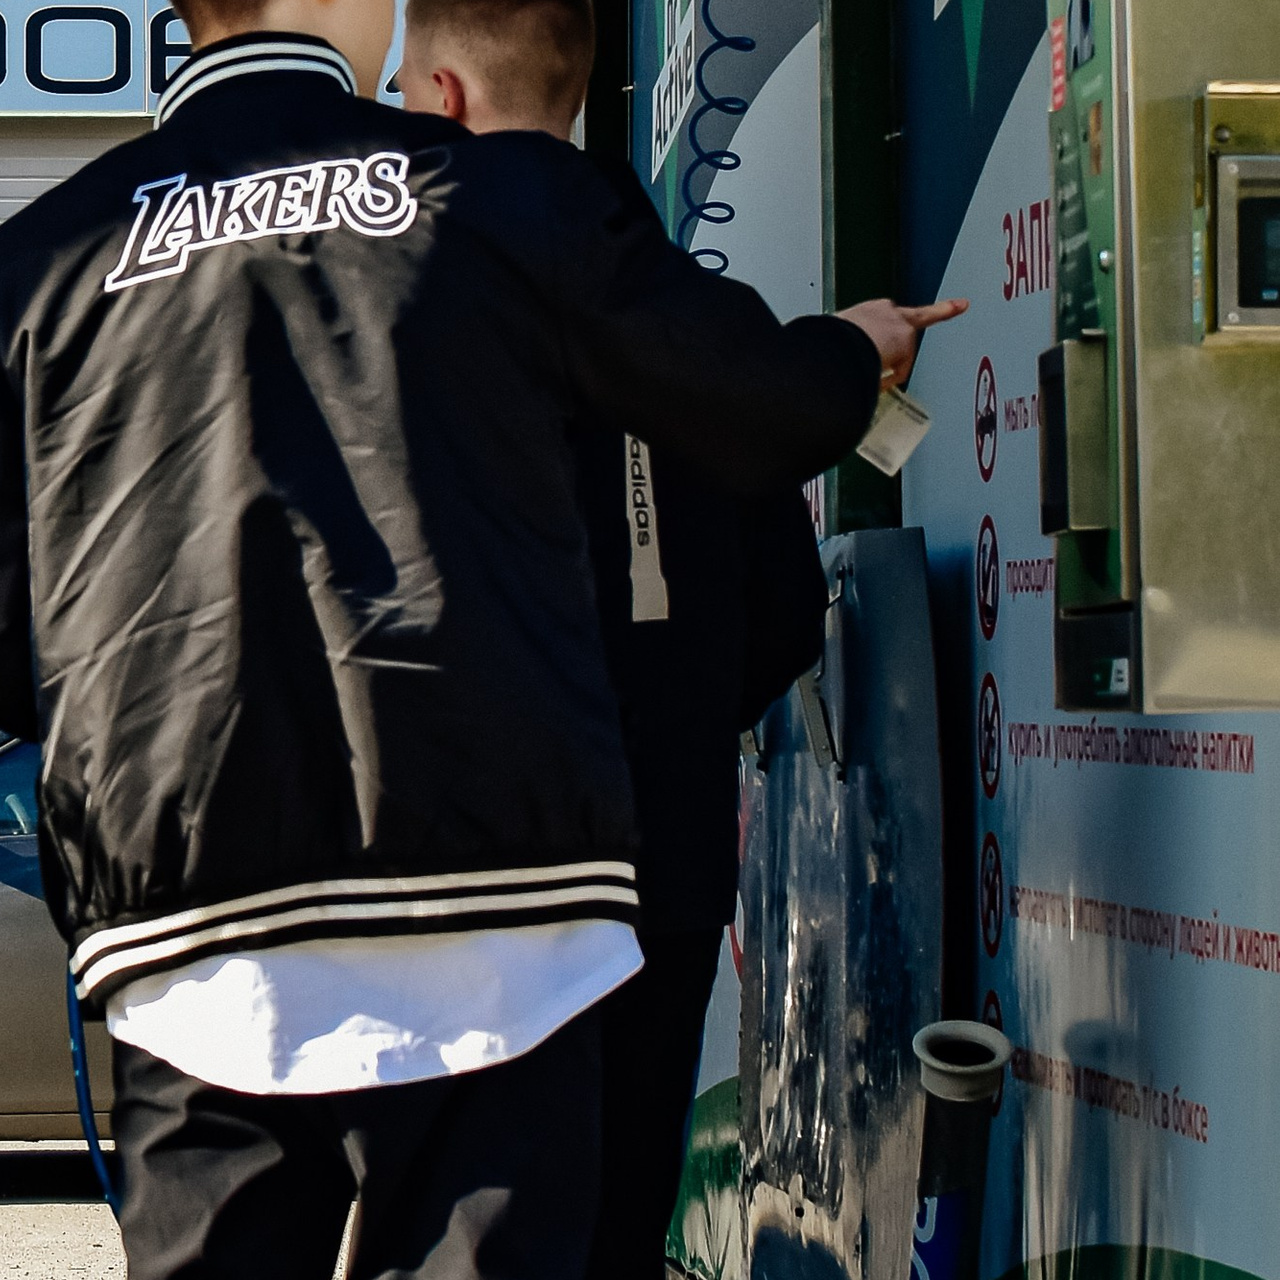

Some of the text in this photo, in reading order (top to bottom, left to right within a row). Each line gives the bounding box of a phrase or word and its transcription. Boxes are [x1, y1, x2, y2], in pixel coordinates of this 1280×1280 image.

[654, 28, 693, 170] Active
[104, 151, 418, 293] LAKERS
[1004, 397, 1028, 433] мыть
[630, 437, 652, 548] adidas
[1008, 722, 1042, 766] курить
[1044, 724, 1051, 758] и
[1123, 727, 1198, 769] алкогольные
[1202, 731, 1255, 774] напитки
[1130, 907, 1176, 960] сторону
[1180, 908, 1220, 965] людей
[1223, 924, 1231, 963] и
[1162, 1092, 1170, 1129] в
[1173, 1084, 1209, 1143] боксе
